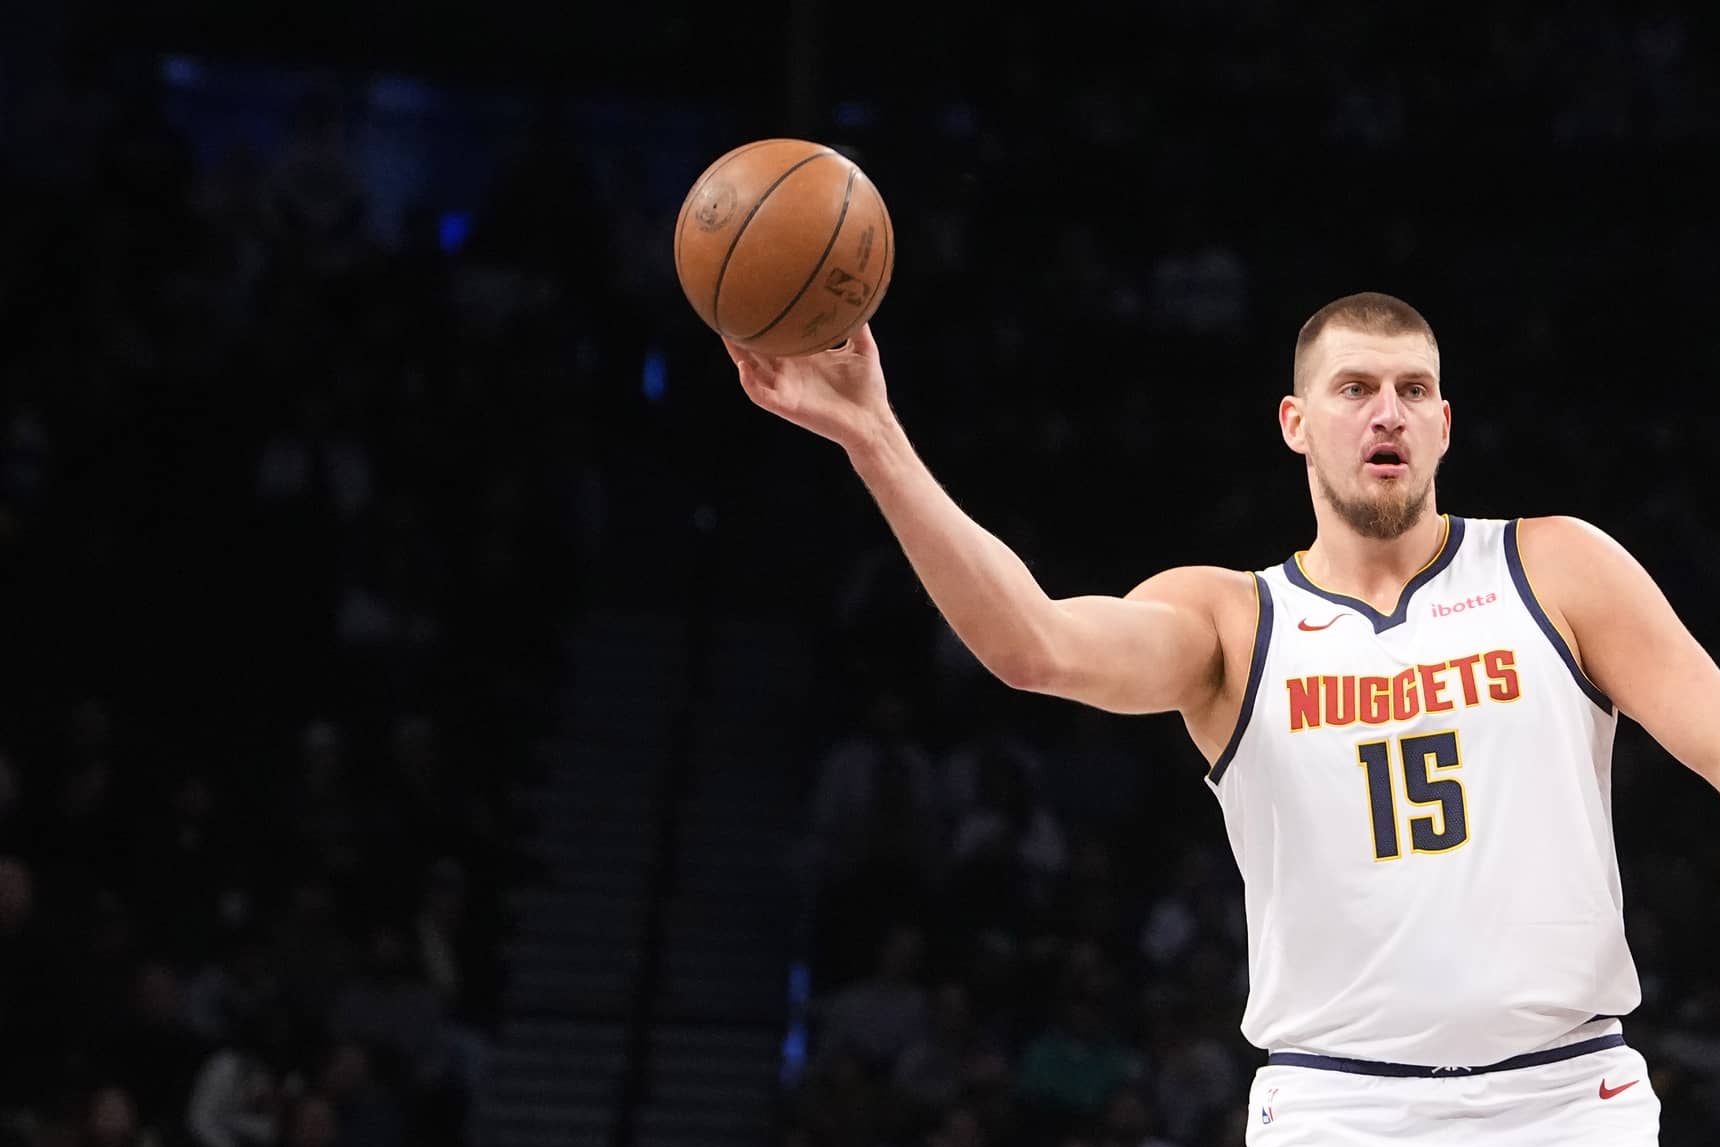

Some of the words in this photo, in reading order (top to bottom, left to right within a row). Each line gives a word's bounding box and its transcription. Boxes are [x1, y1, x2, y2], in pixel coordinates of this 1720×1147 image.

[1431, 592, 1497, 618] ibotta
[1286, 649, 1521, 733] NUGGETS
[1356, 729, 1471, 863] 15
